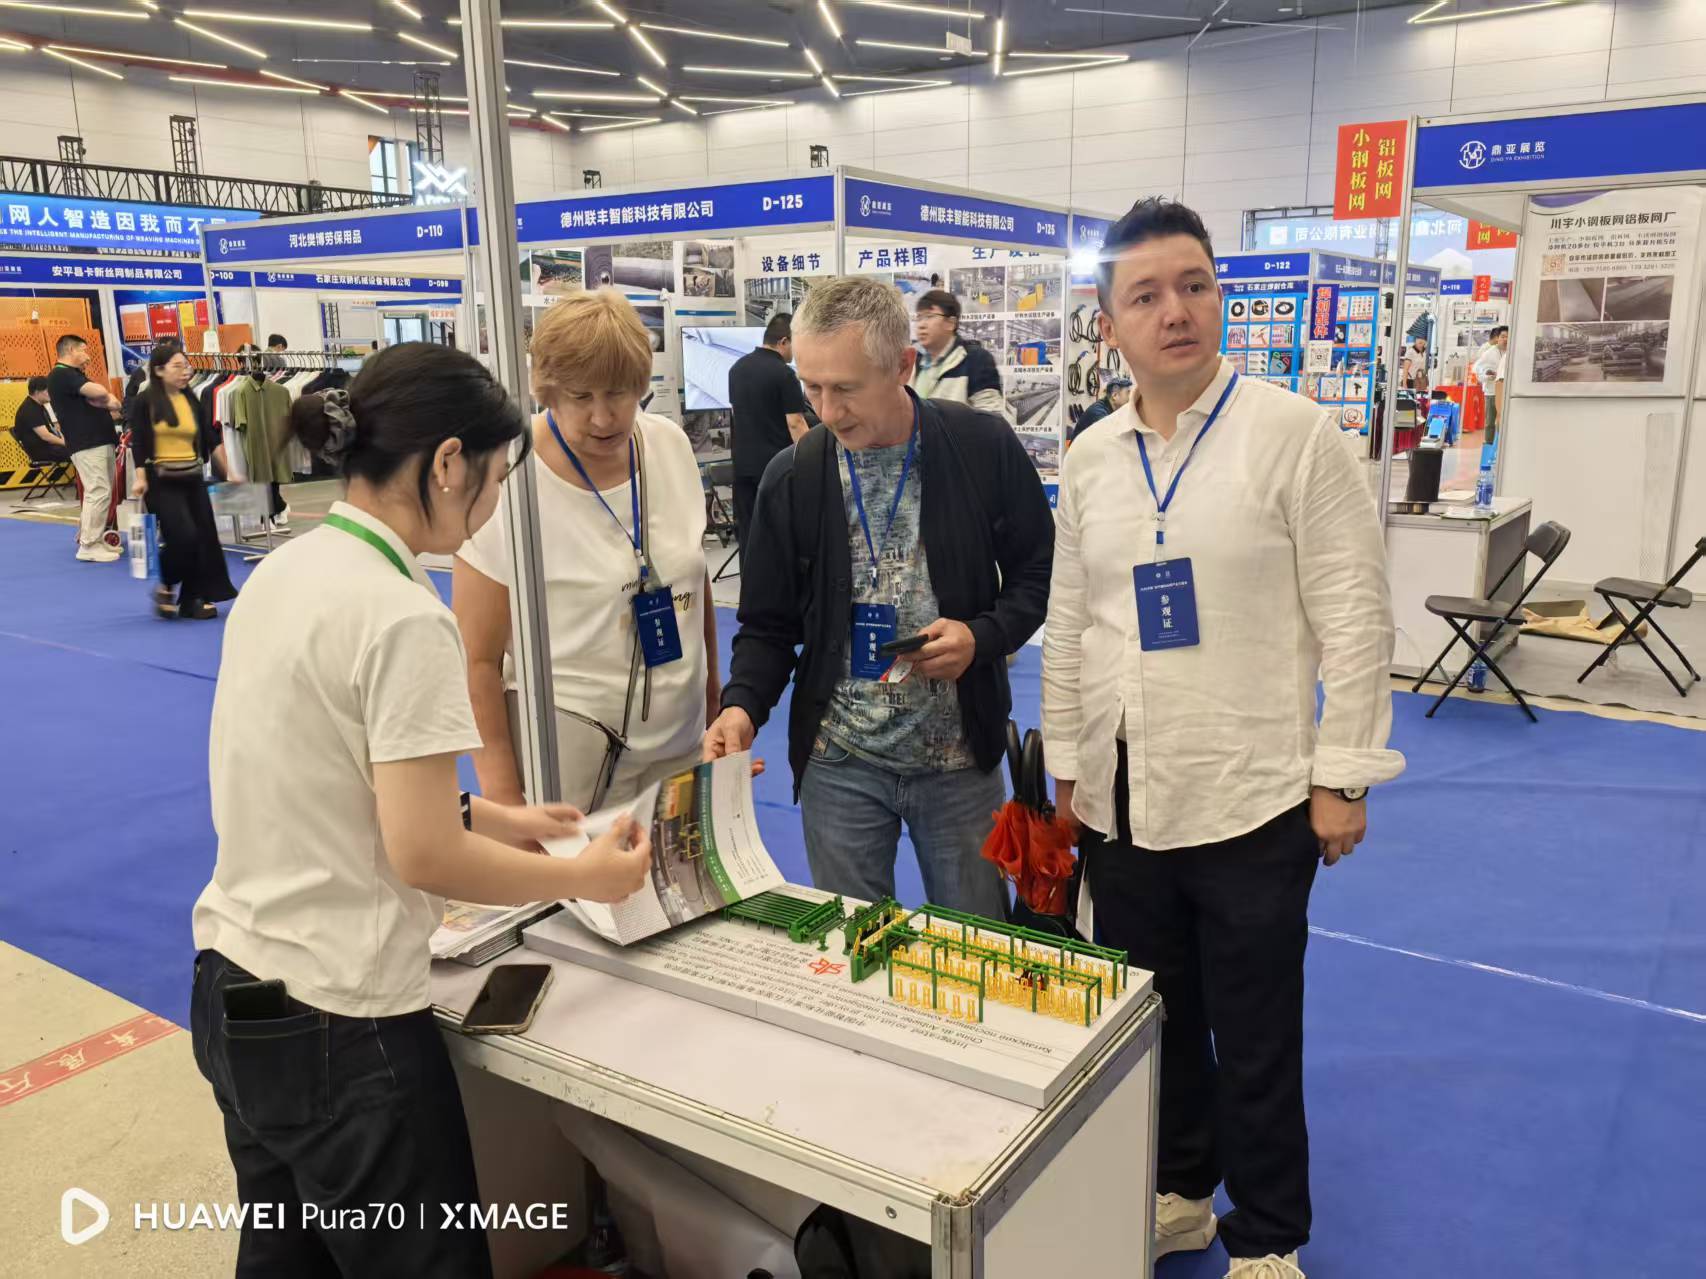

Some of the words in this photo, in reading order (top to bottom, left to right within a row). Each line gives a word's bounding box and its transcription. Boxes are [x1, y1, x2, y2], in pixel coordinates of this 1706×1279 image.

[1491, 140, 1546, 156] 鼎亚展览
[1348, 128, 1371, 212] 小钢板网
[1374, 138, 1396, 200] 铝板网
[0, 203, 227, 235] 网人智造因我而不
[560, 200, 714, 229] 德州联丰智能科技有限公司
[763, 194, 804, 211] D-125
[920, 204, 1014, 232] 德州联丰智能科技有限公司
[416, 224, 443, 238] D-110
[761, 253, 821, 273] 设备细节
[858, 246, 928, 269] 产品样图
[1264, 261, 1291, 270] D-122
[910, 1028, 968, 1049] Integrated
